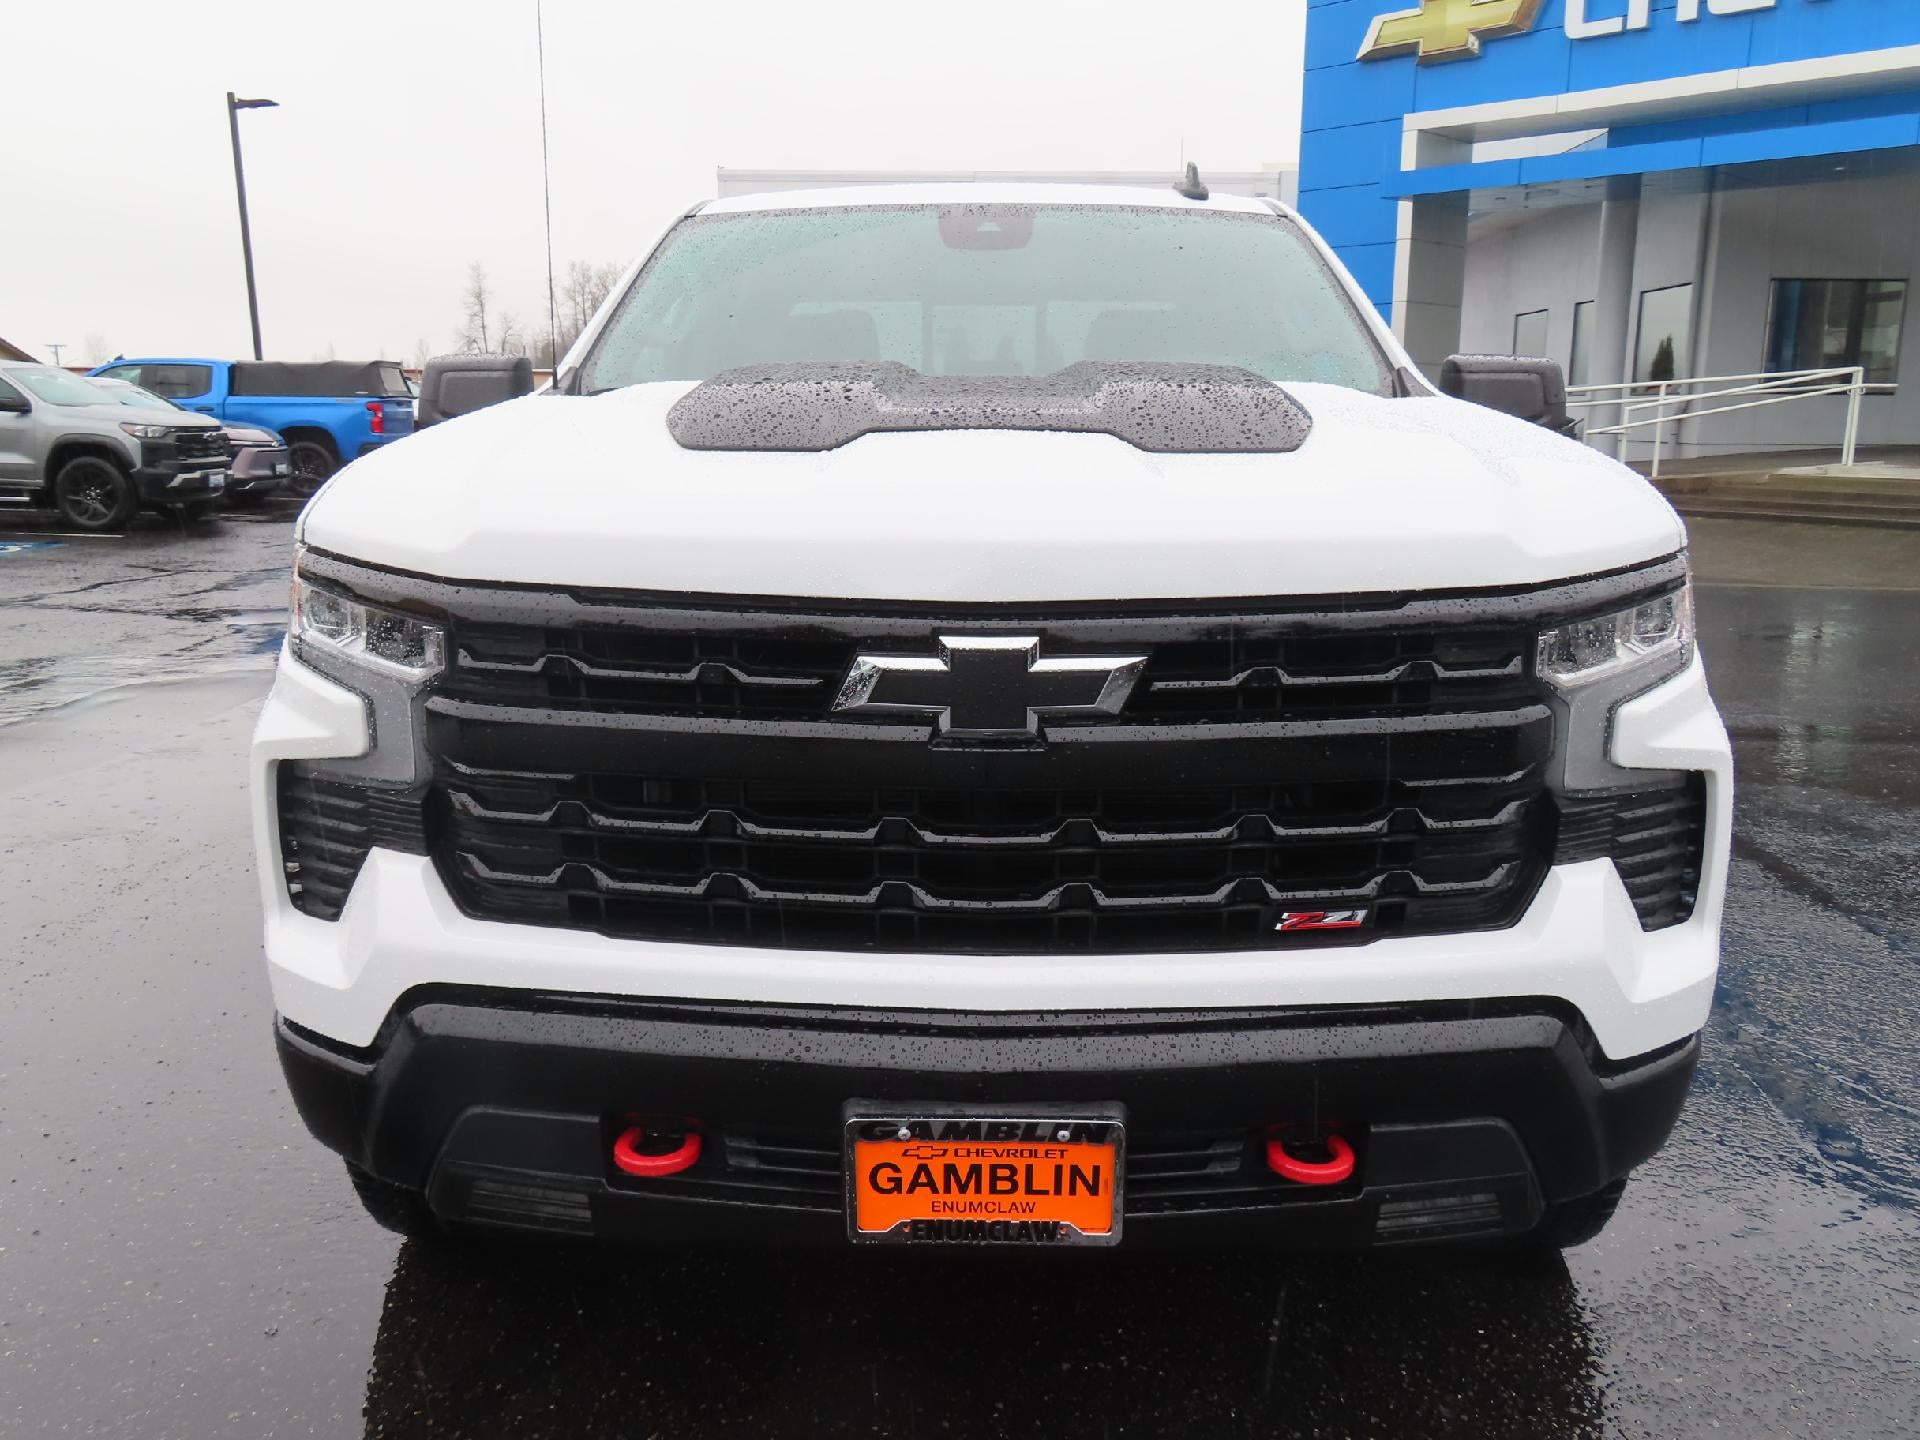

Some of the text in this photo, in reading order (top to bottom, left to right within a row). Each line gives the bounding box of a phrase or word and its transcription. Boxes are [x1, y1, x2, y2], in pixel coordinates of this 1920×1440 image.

[858, 1121, 1110, 1143] GAMBLIN
[954, 1147, 1068, 1160] CHEVROLET
[868, 1162, 1101, 1196] GAMBLIN
[931, 1200, 1036, 1214] ENUMCLAW
[911, 1220, 1060, 1242] ENUMCLAW
